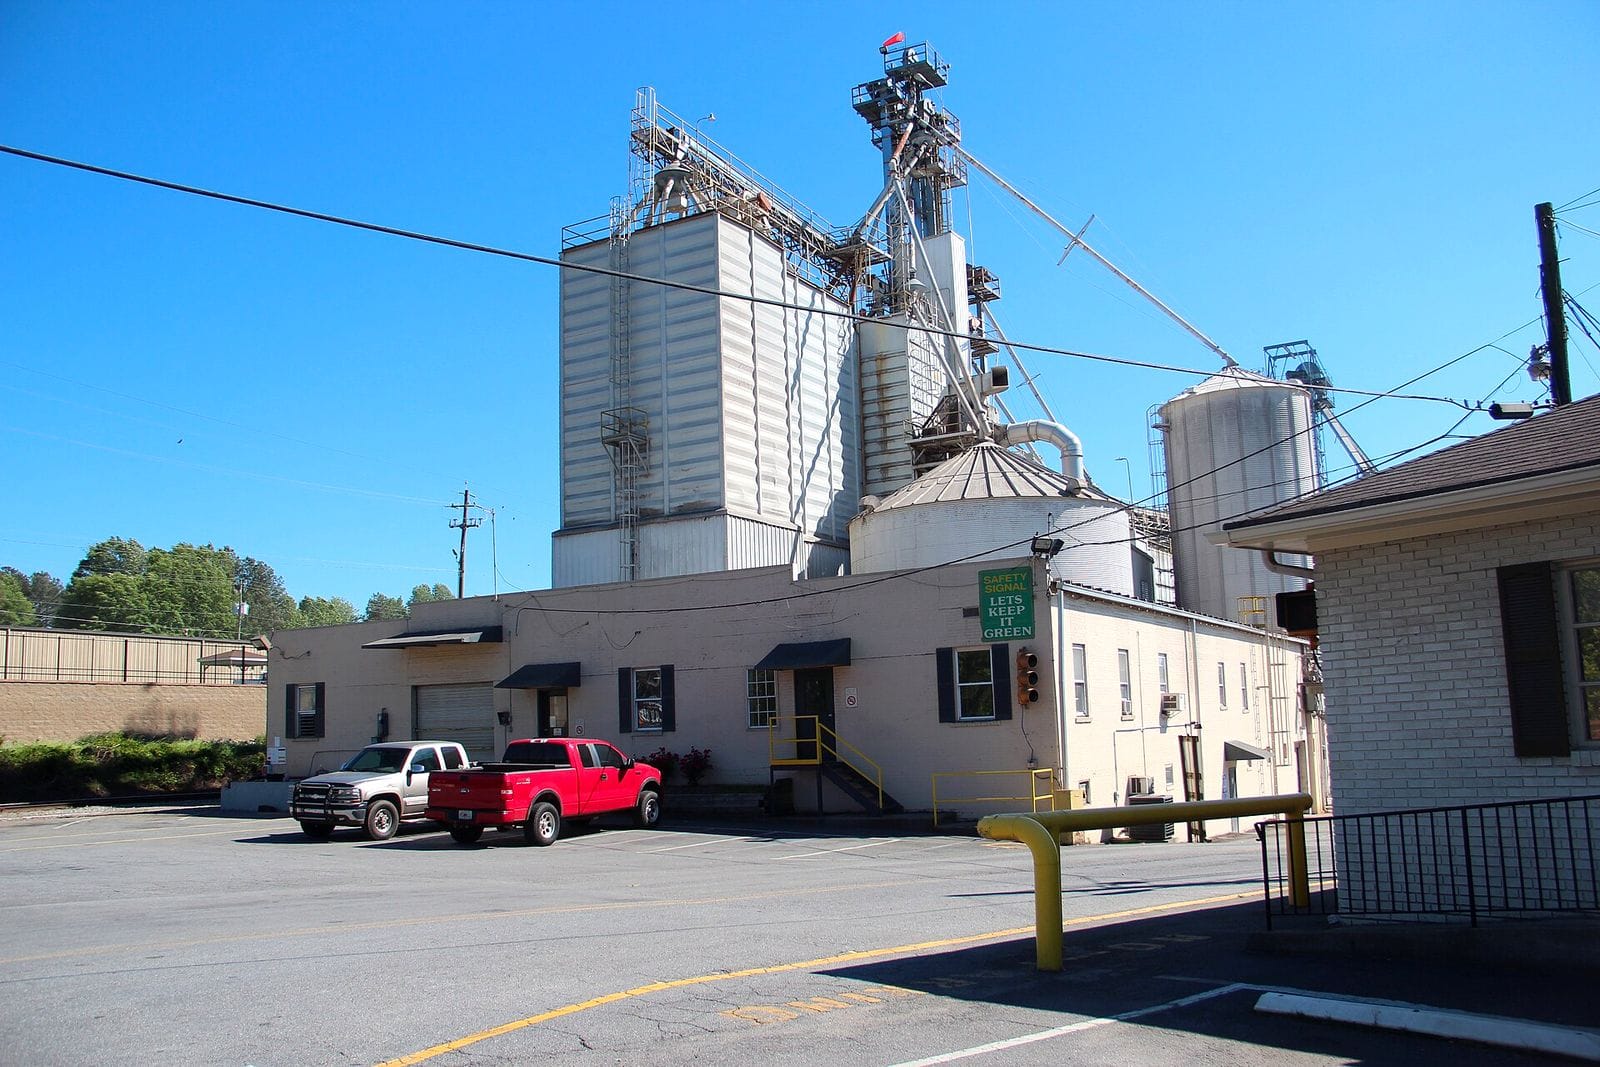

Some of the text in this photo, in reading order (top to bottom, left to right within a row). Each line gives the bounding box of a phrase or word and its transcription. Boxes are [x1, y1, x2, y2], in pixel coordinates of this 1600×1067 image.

[983, 572, 1027, 584] SAFETY
[985, 583, 1027, 593] SIGNAL
[990, 595, 1023, 606] LETS
[988, 605, 1025, 617] KEEP
[1000, 617, 1014, 626] IT
[984, 626, 1032, 638] GREEN
